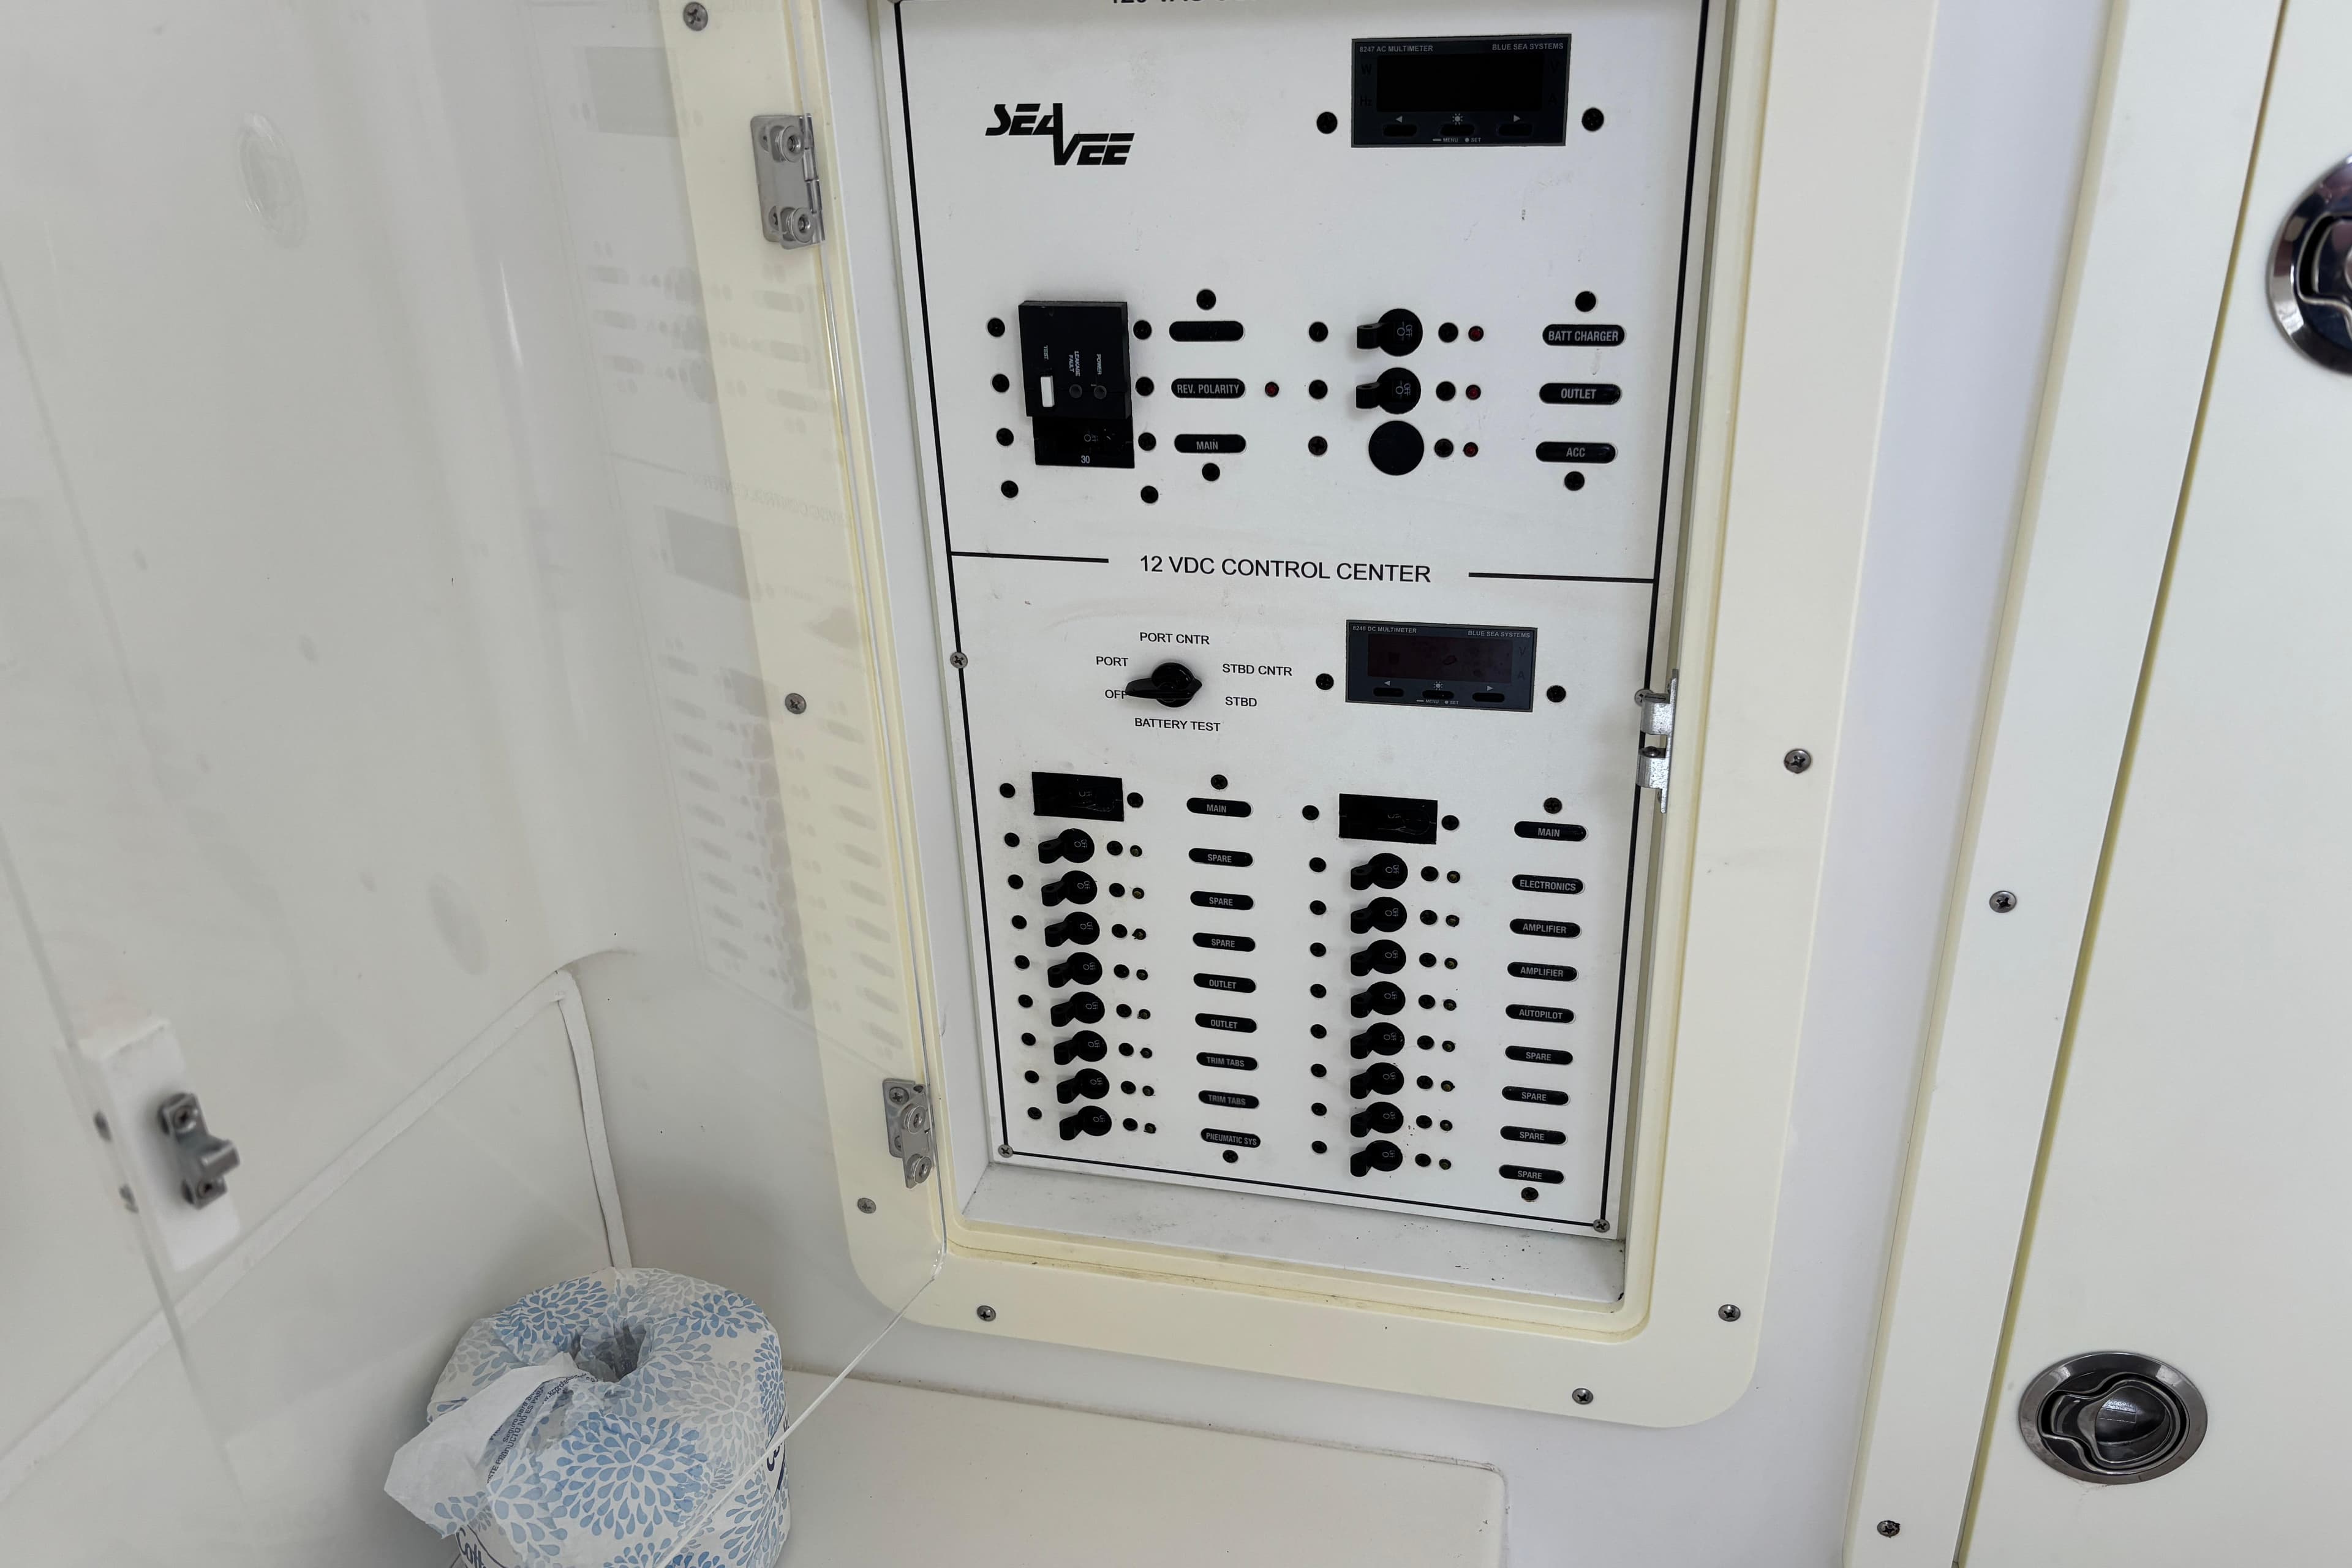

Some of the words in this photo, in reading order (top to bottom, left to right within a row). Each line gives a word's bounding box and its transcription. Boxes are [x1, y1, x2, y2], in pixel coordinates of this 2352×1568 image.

[1548, 330, 1572, 341] BATT
[1574, 330, 1619, 342] CHARGER
[1177, 384, 1196, 394] REV.
[1198, 384, 1240, 394] POLARITY
[1561, 388, 1597, 399] OUTLET
[1196, 441, 1218, 450] MAIN
[1566, 447, 1586, 458] ACC
[1080, 454, 1090, 464] 30
[1140, 555, 1163, 572] 12
[1168, 556, 1215, 575] VDC
[1221, 558, 1331, 579] CONTROL
[1336, 562, 1431, 583] CENTER
[1140, 631, 1173, 643] PORT
[1175, 634, 1210, 645] CNTR
[1096, 656, 1129, 667] PORT
[1222, 663, 1255, 674] STBD
[1258, 665, 1292, 676] CNTR
[1104, 689, 1127, 699] OFF
[1225, 696, 1257, 707] STBD
[1134, 717, 1188, 729] BATTERY
[1189, 721, 1221, 732] TEST
[1207, 804, 1227, 813] MAIN
[1537, 827, 1560, 837] MAIN
[1207, 853, 1232, 863] SPARE
[1520, 880, 1576, 891] ELECTRONICS
[1208, 897, 1234, 907] SPARE
[1523, 923, 1566, 934] AMPLIFIER
[1211, 938, 1236, 948] SPARE
[1520, 966, 1563, 978] AMPLIFIER
[1209, 979, 1237, 989] OUTLET
[1519, 1009, 1563, 1020] AUTOPILOT
[1211, 1019, 1238, 1029] OUTLET
[1205, 1055, 1225, 1065] TRIM
[1226, 1057, 1246, 1068] TABS
[1526, 1052, 1551, 1061] SPARE
[1207, 1093, 1226, 1103] TRIM
[1227, 1095, 1247, 1107] TABS
[1521, 1092, 1546, 1101] SPARE
[1205, 1131, 1243, 1145] PNEUMATIC
[1243, 1136, 1257, 1146] SYS
[1520, 1132, 1544, 1140] SPARE
[1518, 1170, 1542, 1180] SPARE
[518, 1415, 528, 1427] NO
[524, 1404, 534, 1415] ES
[502, 1419, 518, 1443] Seguro
